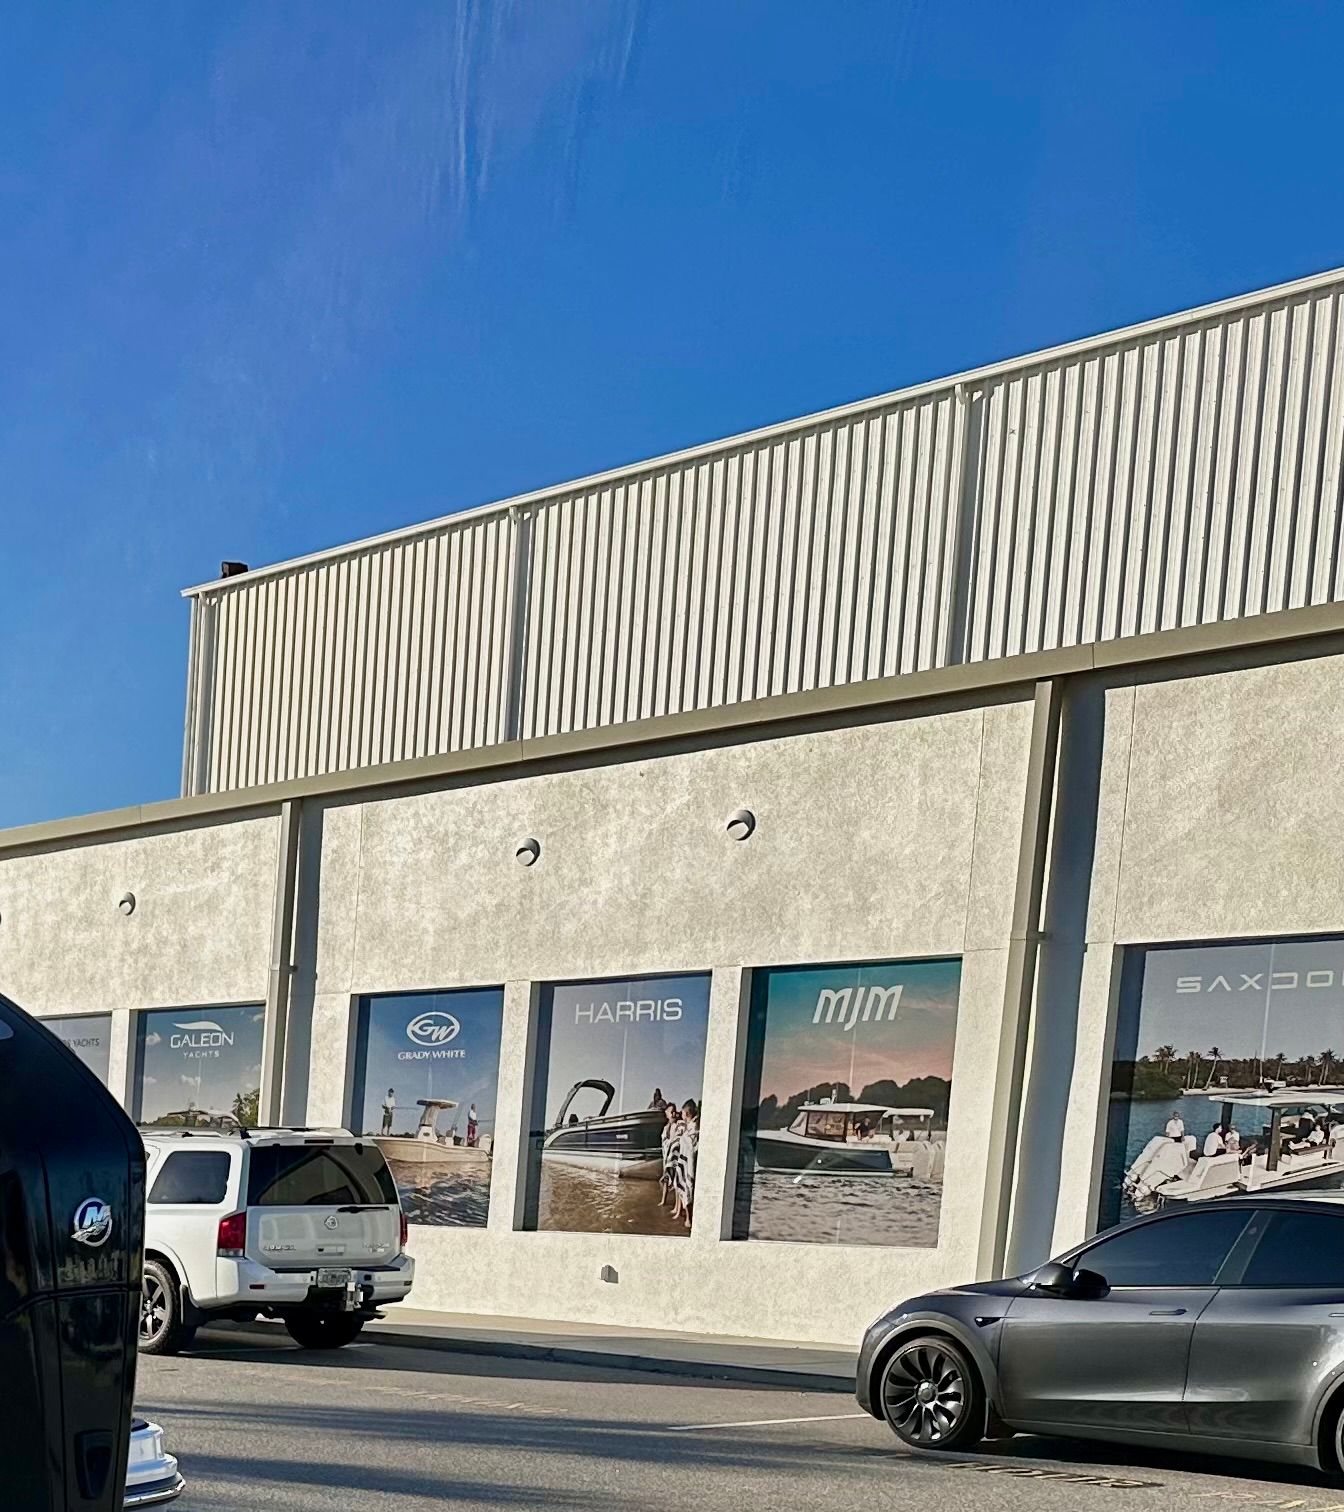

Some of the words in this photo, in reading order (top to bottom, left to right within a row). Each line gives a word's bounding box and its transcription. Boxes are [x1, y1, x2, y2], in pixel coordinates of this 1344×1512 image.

[1176, 970, 1344, 994] SAXDO
[575, 998, 683, 1025] HARRIS
[170, 1031, 234, 1049] GALEON
[183, 1050, 220, 1058] YACHTS
[397, 1051, 430, 1061] GRADY
[432, 1049, 465, 1059] WHITE
